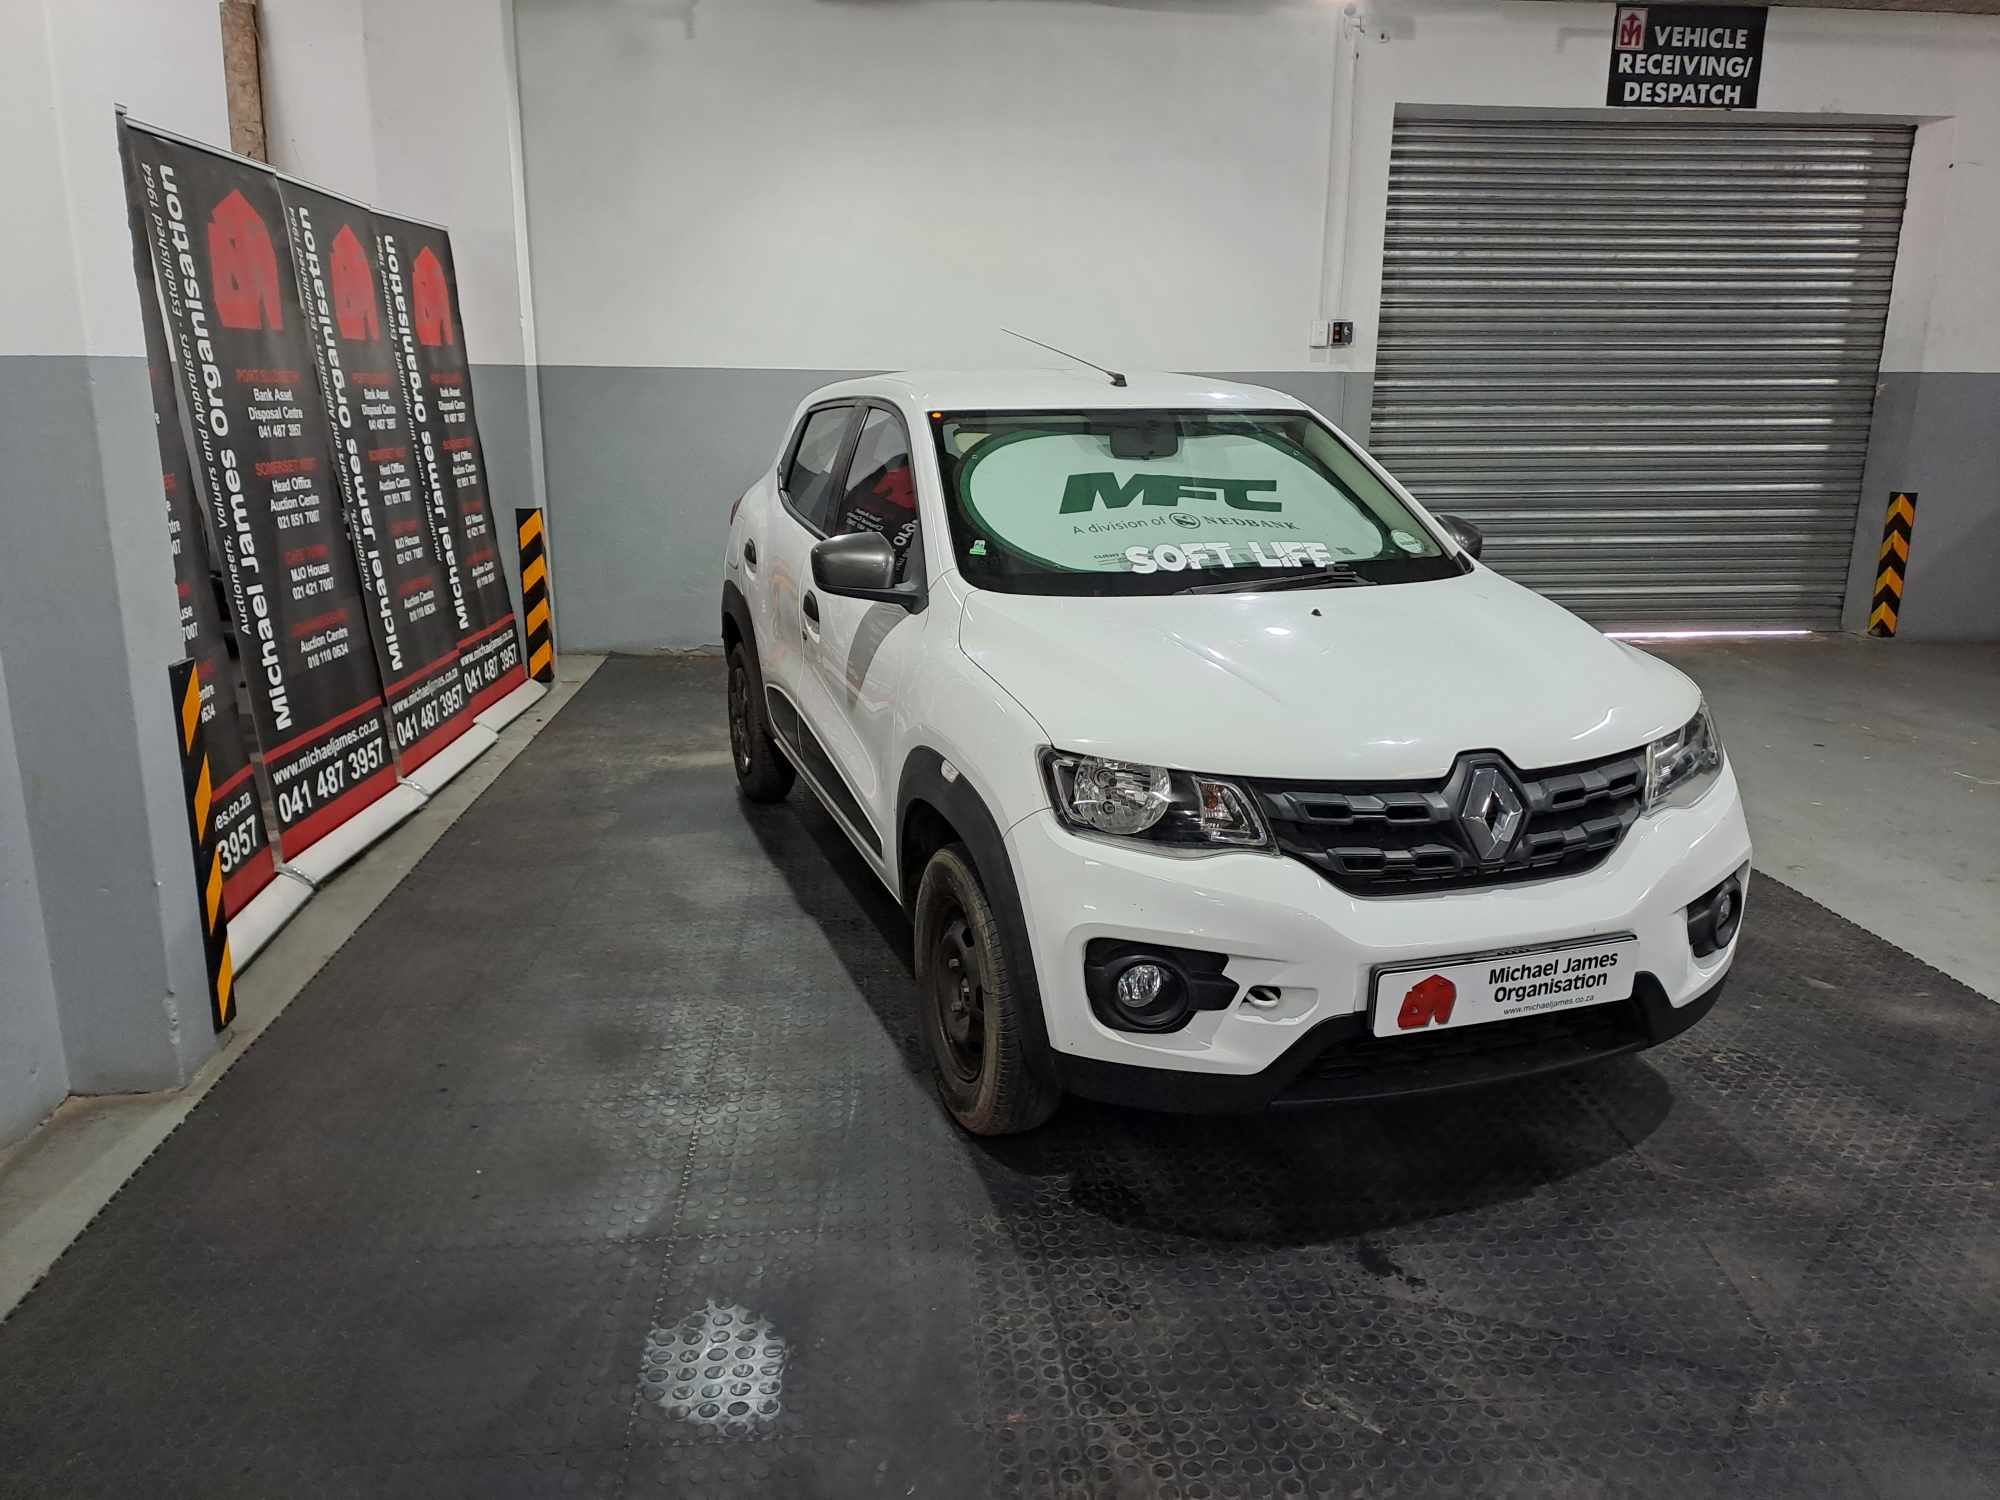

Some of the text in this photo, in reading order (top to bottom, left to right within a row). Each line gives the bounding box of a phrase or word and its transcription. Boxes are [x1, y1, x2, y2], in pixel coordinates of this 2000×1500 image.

[1654, 26, 1748, 49] VEHICLE
[1618, 53, 1753, 78] RECEIVING/
[1623, 82, 1741, 105] DESPATCH
[141, 161, 160, 208] 1964
[151, 212, 183, 317] Established
[298, 206, 352, 429] Organisation
[384, 235, 427, 423] Organisation
[178, 333, 206, 425] Appraisers
[253, 387, 274, 401] Bank
[248, 406, 283, 423] Disposal
[258, 425, 272, 439] 041
[272, 424, 286, 438] 487
[159, 164, 292, 731] Michael James Organisation
[198, 428, 214, 462] and
[291, 476, 312, 490] Office
[345, 439, 376, 542] James
[420, 431, 447, 519] James
[1059, 472, 1283, 514] MFC
[207, 467, 229, 528] Valuers
[270, 498, 298, 512] Auction
[1073, 515, 1301, 535] A division of NEDBANK
[307, 563, 330, 578] House
[1125, 541, 1235, 574] SOFT
[292, 586, 305, 600] 021
[305, 583, 319, 597] 421
[438, 526, 470, 630] Michael
[367, 550, 404, 672] Michael
[300, 626, 349, 653] Auction Centre
[464, 643, 518, 694] 041 487 3957
[396, 683, 464, 747] 041 487 3957
[272, 717, 380, 786] www.michaeljames.co.za
[278, 780, 313, 824] 041
[317, 759, 345, 799] 487
[348, 736, 384, 781] 3957
[217, 814, 257, 874] 3957
[1488, 952, 1619, 985] Michael James
[1494, 971, 1608, 1003] Organisation
[1503, 994, 1595, 1016] www.michaeljames.co.za
